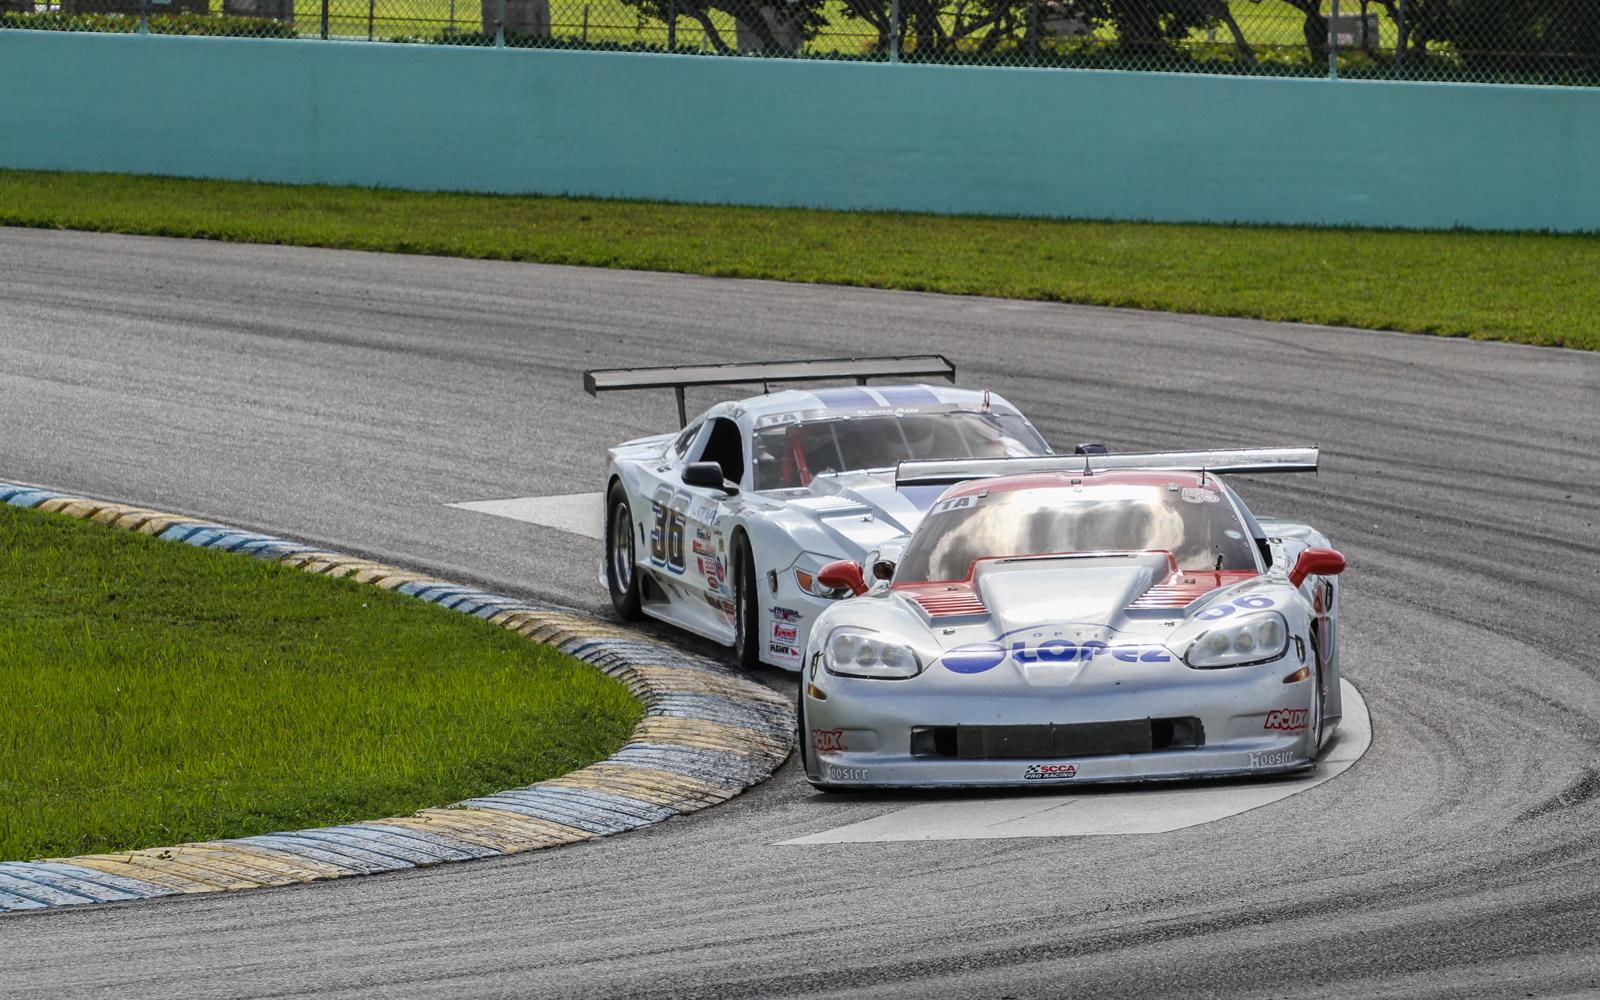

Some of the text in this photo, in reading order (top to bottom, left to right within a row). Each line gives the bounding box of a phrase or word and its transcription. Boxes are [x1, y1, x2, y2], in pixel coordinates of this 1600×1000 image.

[941, 497, 970, 510] TA
[650, 483, 692, 575] 36
[770, 644, 789, 655] HAWK
[1012, 639, 1170, 663] LOPEZ
[1264, 708, 1307, 730] ROUX
[812, 729, 842, 751] OUX
